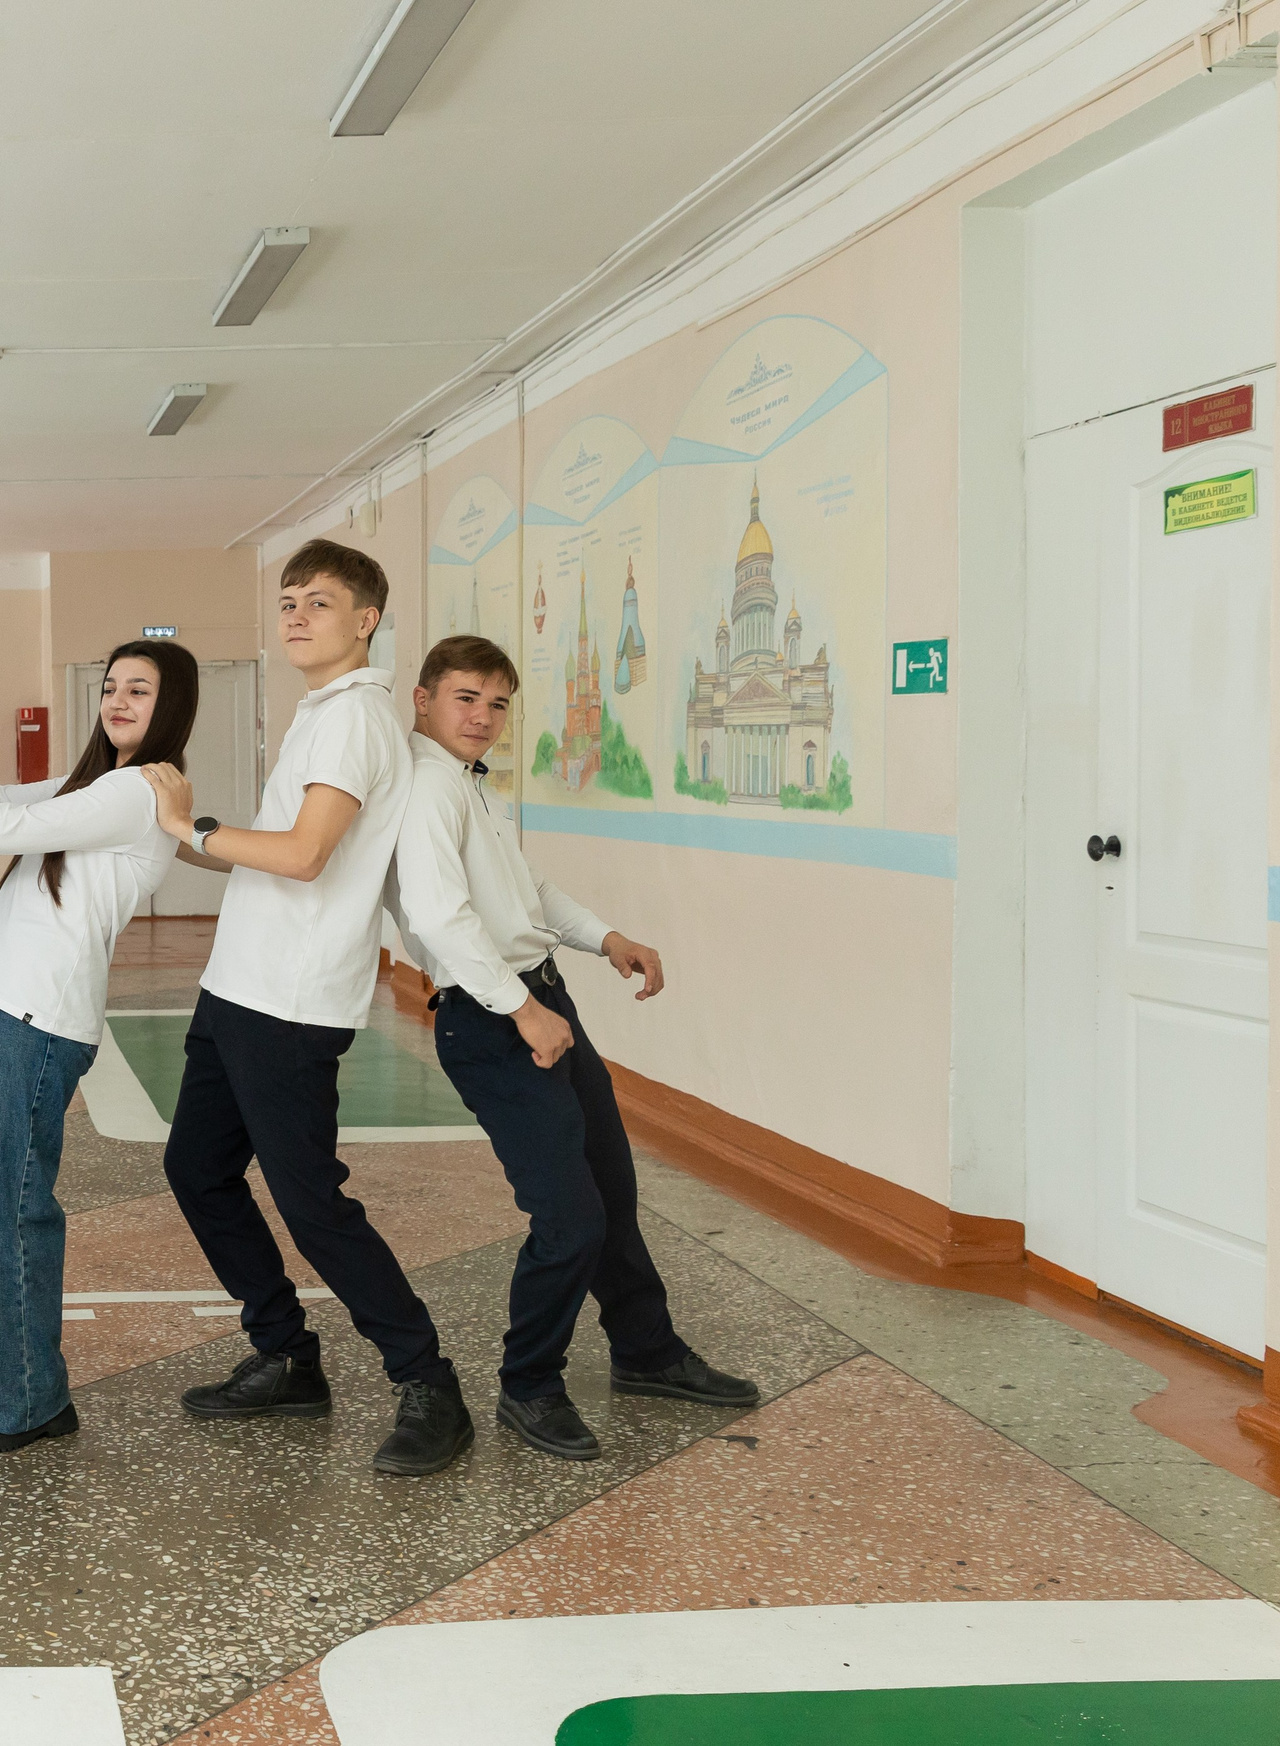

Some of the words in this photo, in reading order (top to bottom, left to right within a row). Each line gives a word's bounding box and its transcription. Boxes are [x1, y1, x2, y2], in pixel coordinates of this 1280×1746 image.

[730, 407, 761, 425] ЧУДЕСА
[764, 394, 789, 411] МИРА
[1203, 394, 1236, 412] КАБИНЕТ
[1192, 404, 1248, 427] ИНОСТРАННОГО
[1170, 418, 1182, 436] 12
[1181, 483, 1233, 503] ВНИМАНИЕ!
[1171, 508, 1177, 517] В
[1178, 500, 1215, 515] КАБИНЕТЕ
[1216, 492, 1248, 507] ВЕДЕТСЯ
[1173, 505, 1246, 527] ВИДЕОНАБЛЮДЕНИЕ
